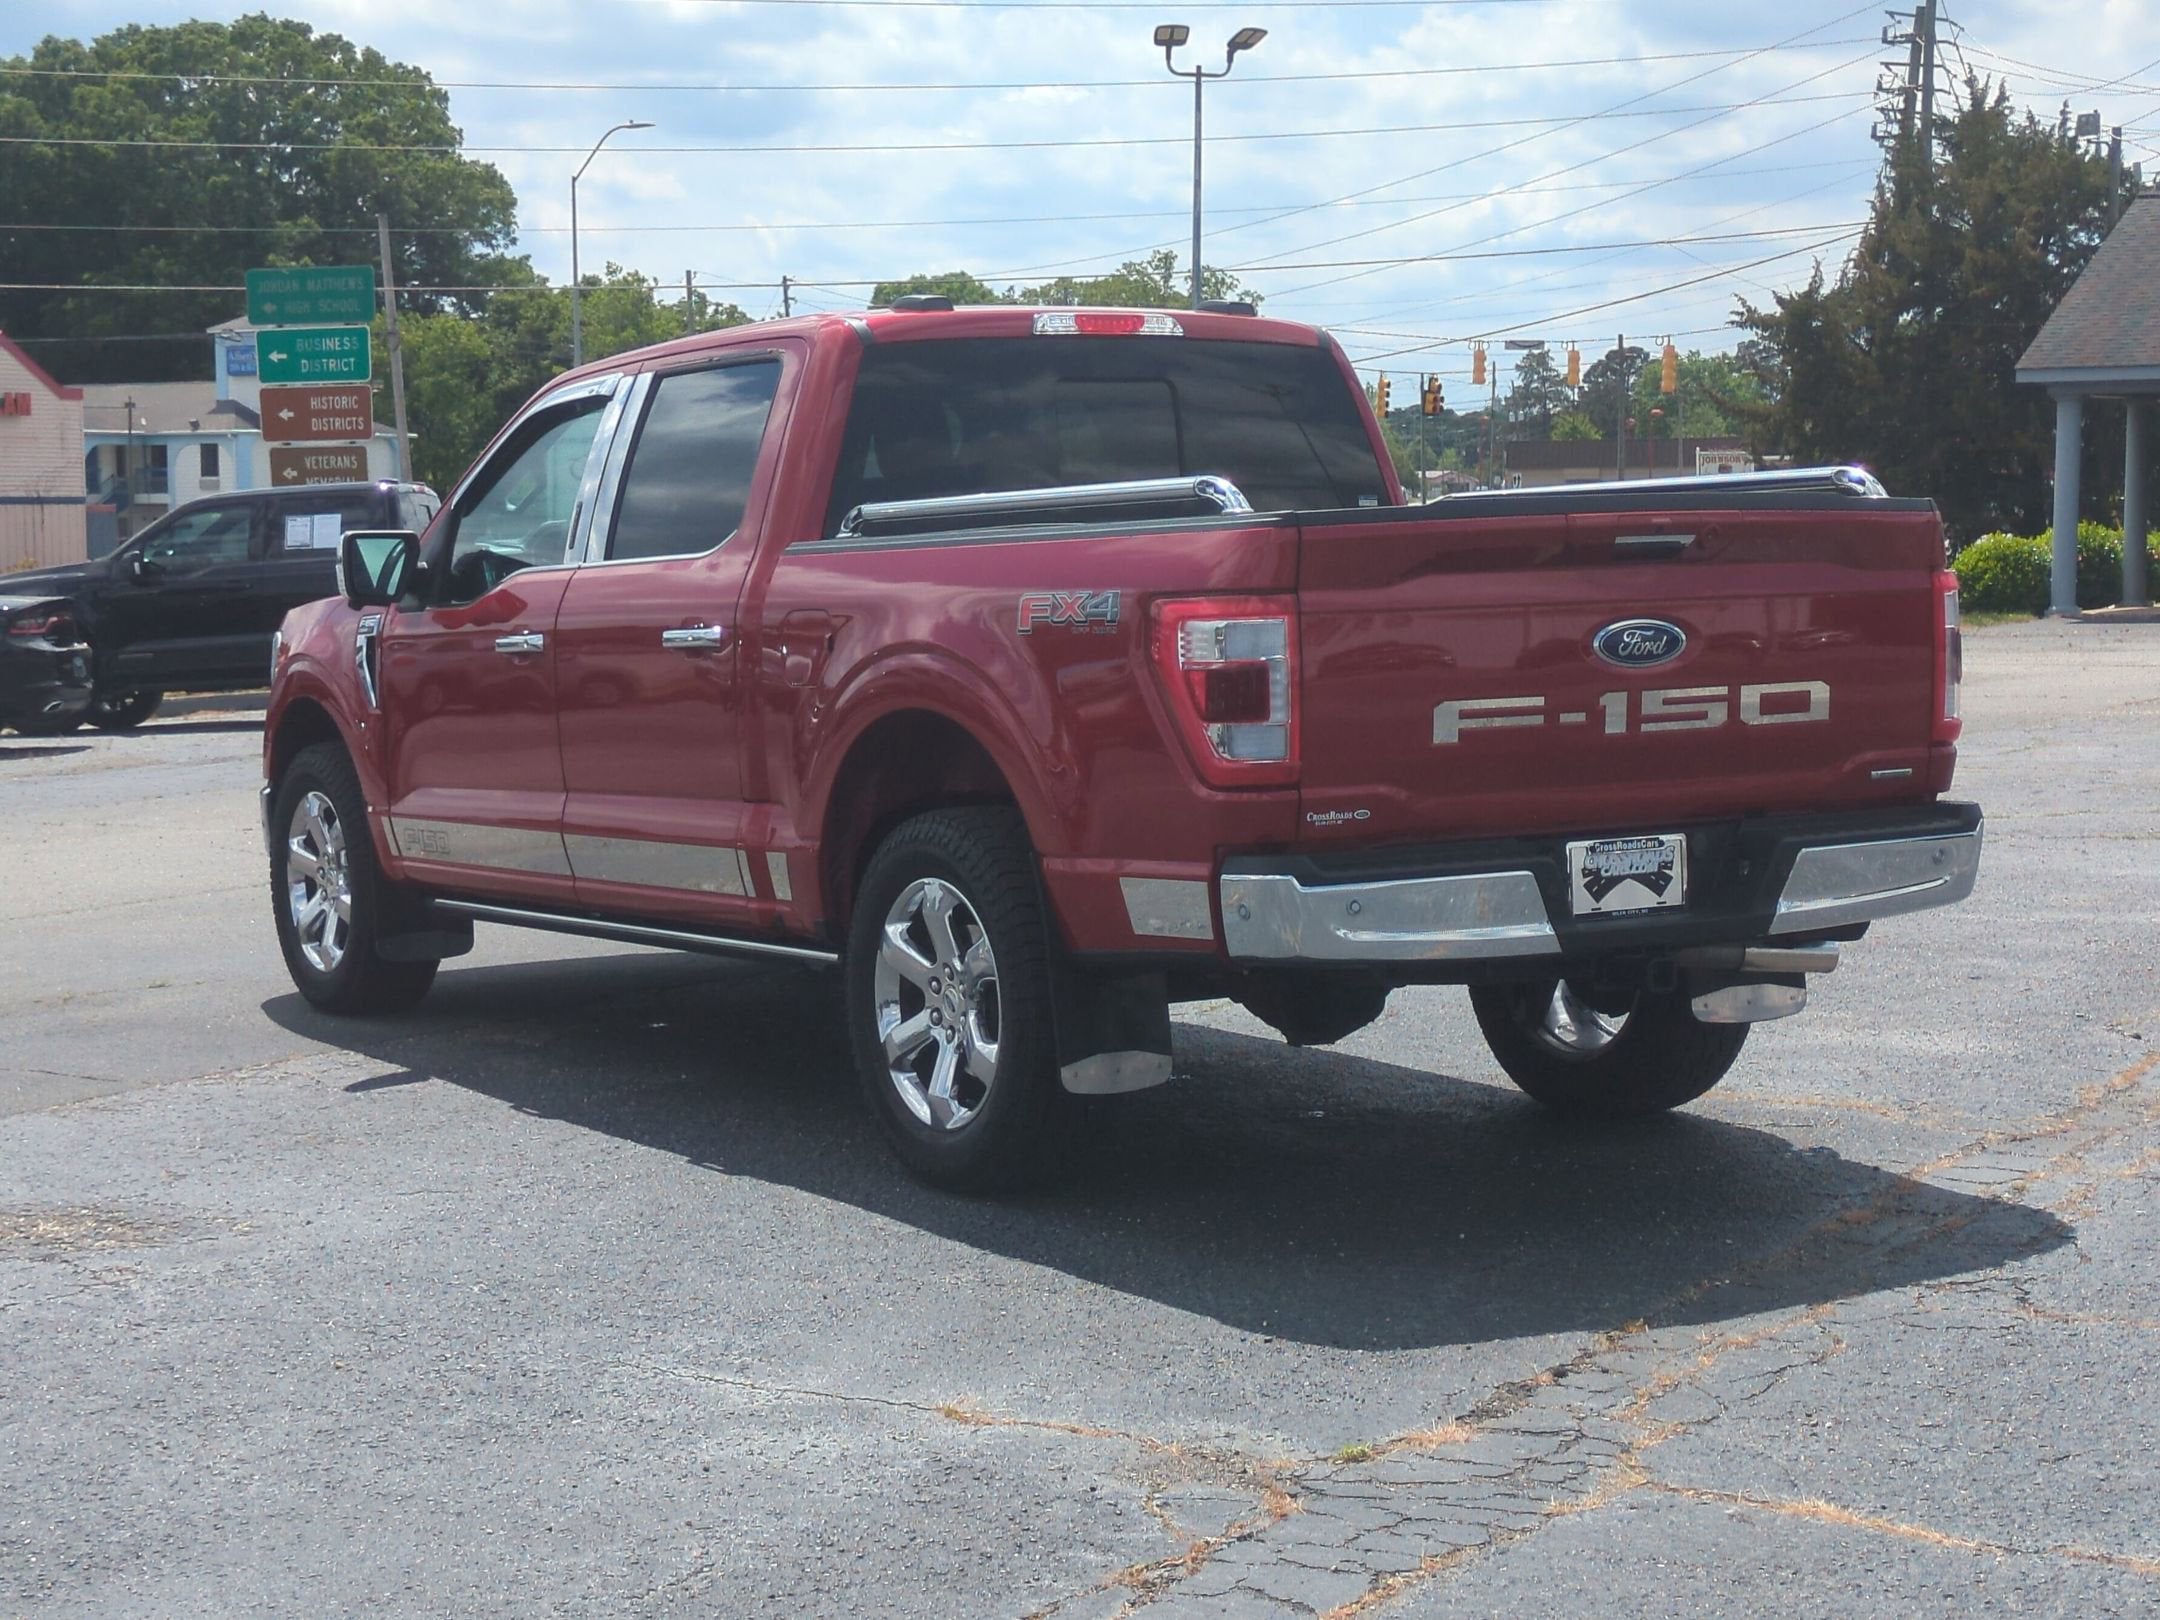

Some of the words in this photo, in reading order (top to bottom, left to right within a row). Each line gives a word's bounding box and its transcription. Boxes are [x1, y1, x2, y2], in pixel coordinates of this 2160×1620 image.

[296, 337, 359, 352] BUSINESS
[301, 358, 355, 373] DISTRICT
[310, 396, 358, 410] HISTORIC
[311, 417, 364, 431] DISTRICTS
[304, 456, 358, 469] VETERANS
[1017, 590, 1120, 634] FX4
[1617, 629, 1667, 657] Ford
[1432, 680, 1830, 744] F-150
